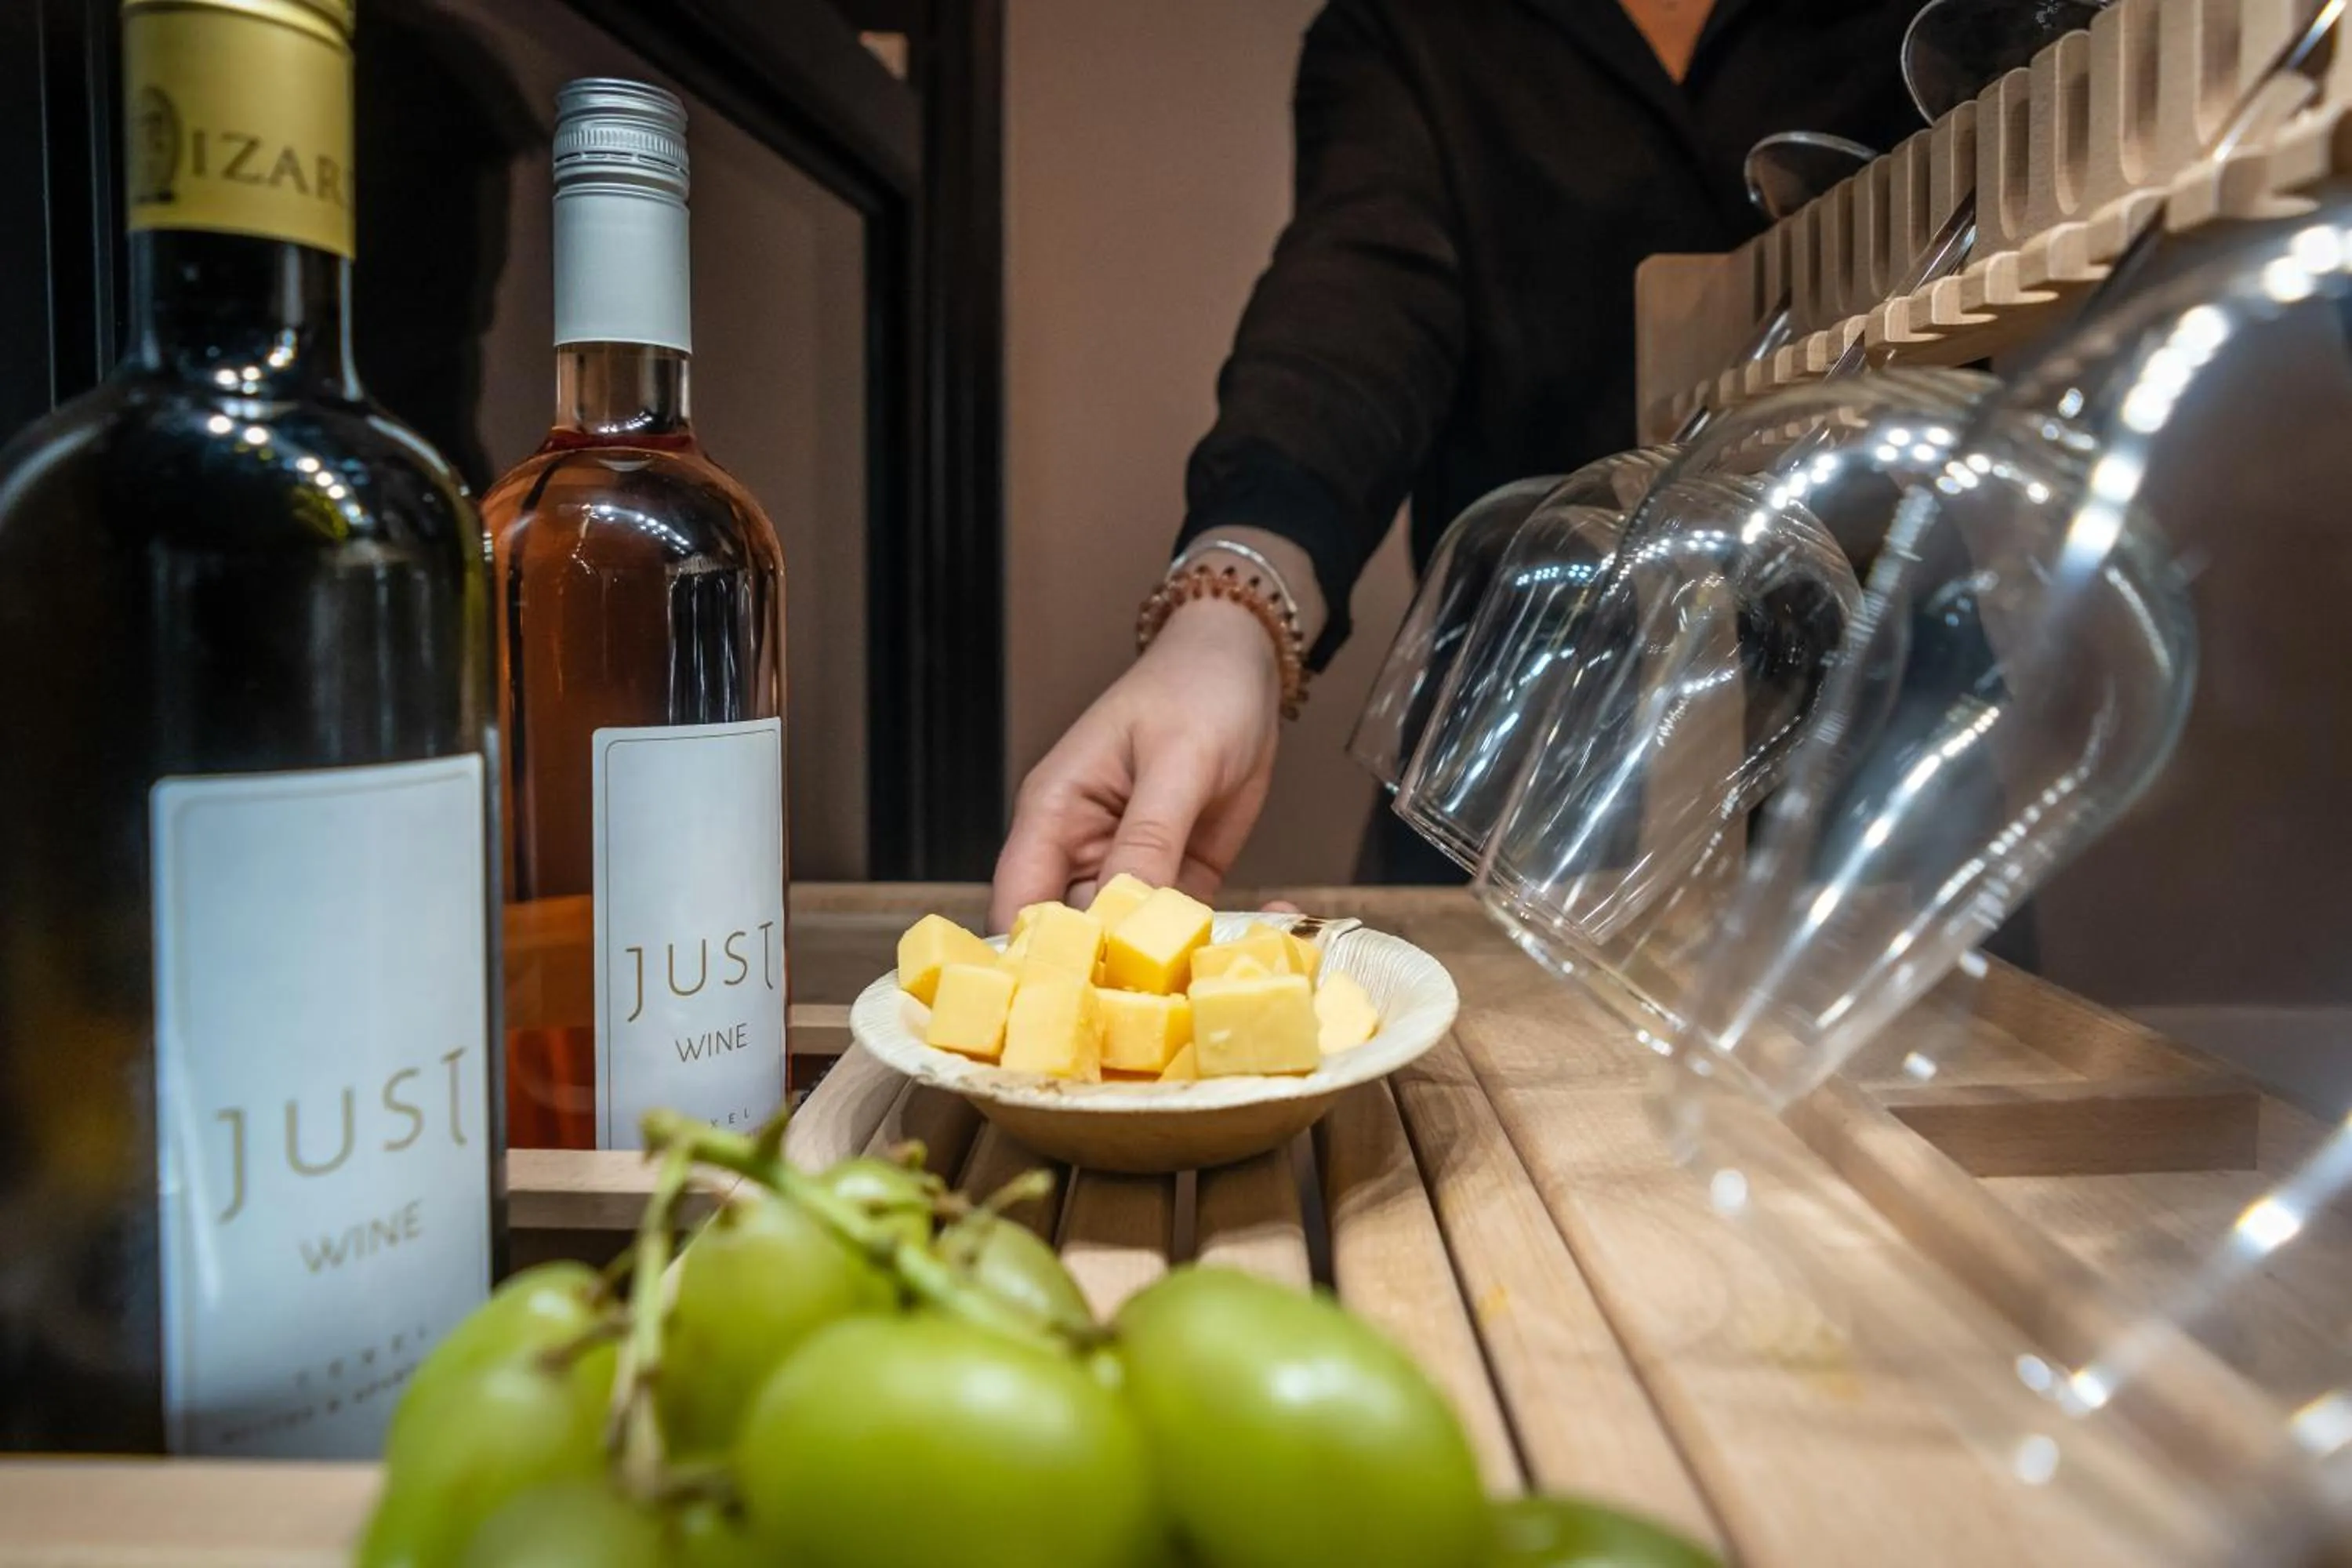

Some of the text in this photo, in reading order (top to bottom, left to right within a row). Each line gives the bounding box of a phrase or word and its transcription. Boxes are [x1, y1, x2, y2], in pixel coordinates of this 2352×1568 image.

[191, 129, 352, 209] IZAR
[625, 920, 775, 1023] JUST
[675, 1022, 749, 1062] WINE
[213, 1046, 469, 1225] JUST
[710, 1107, 751, 1128] XEL
[298, 1197, 424, 1274] WINE
